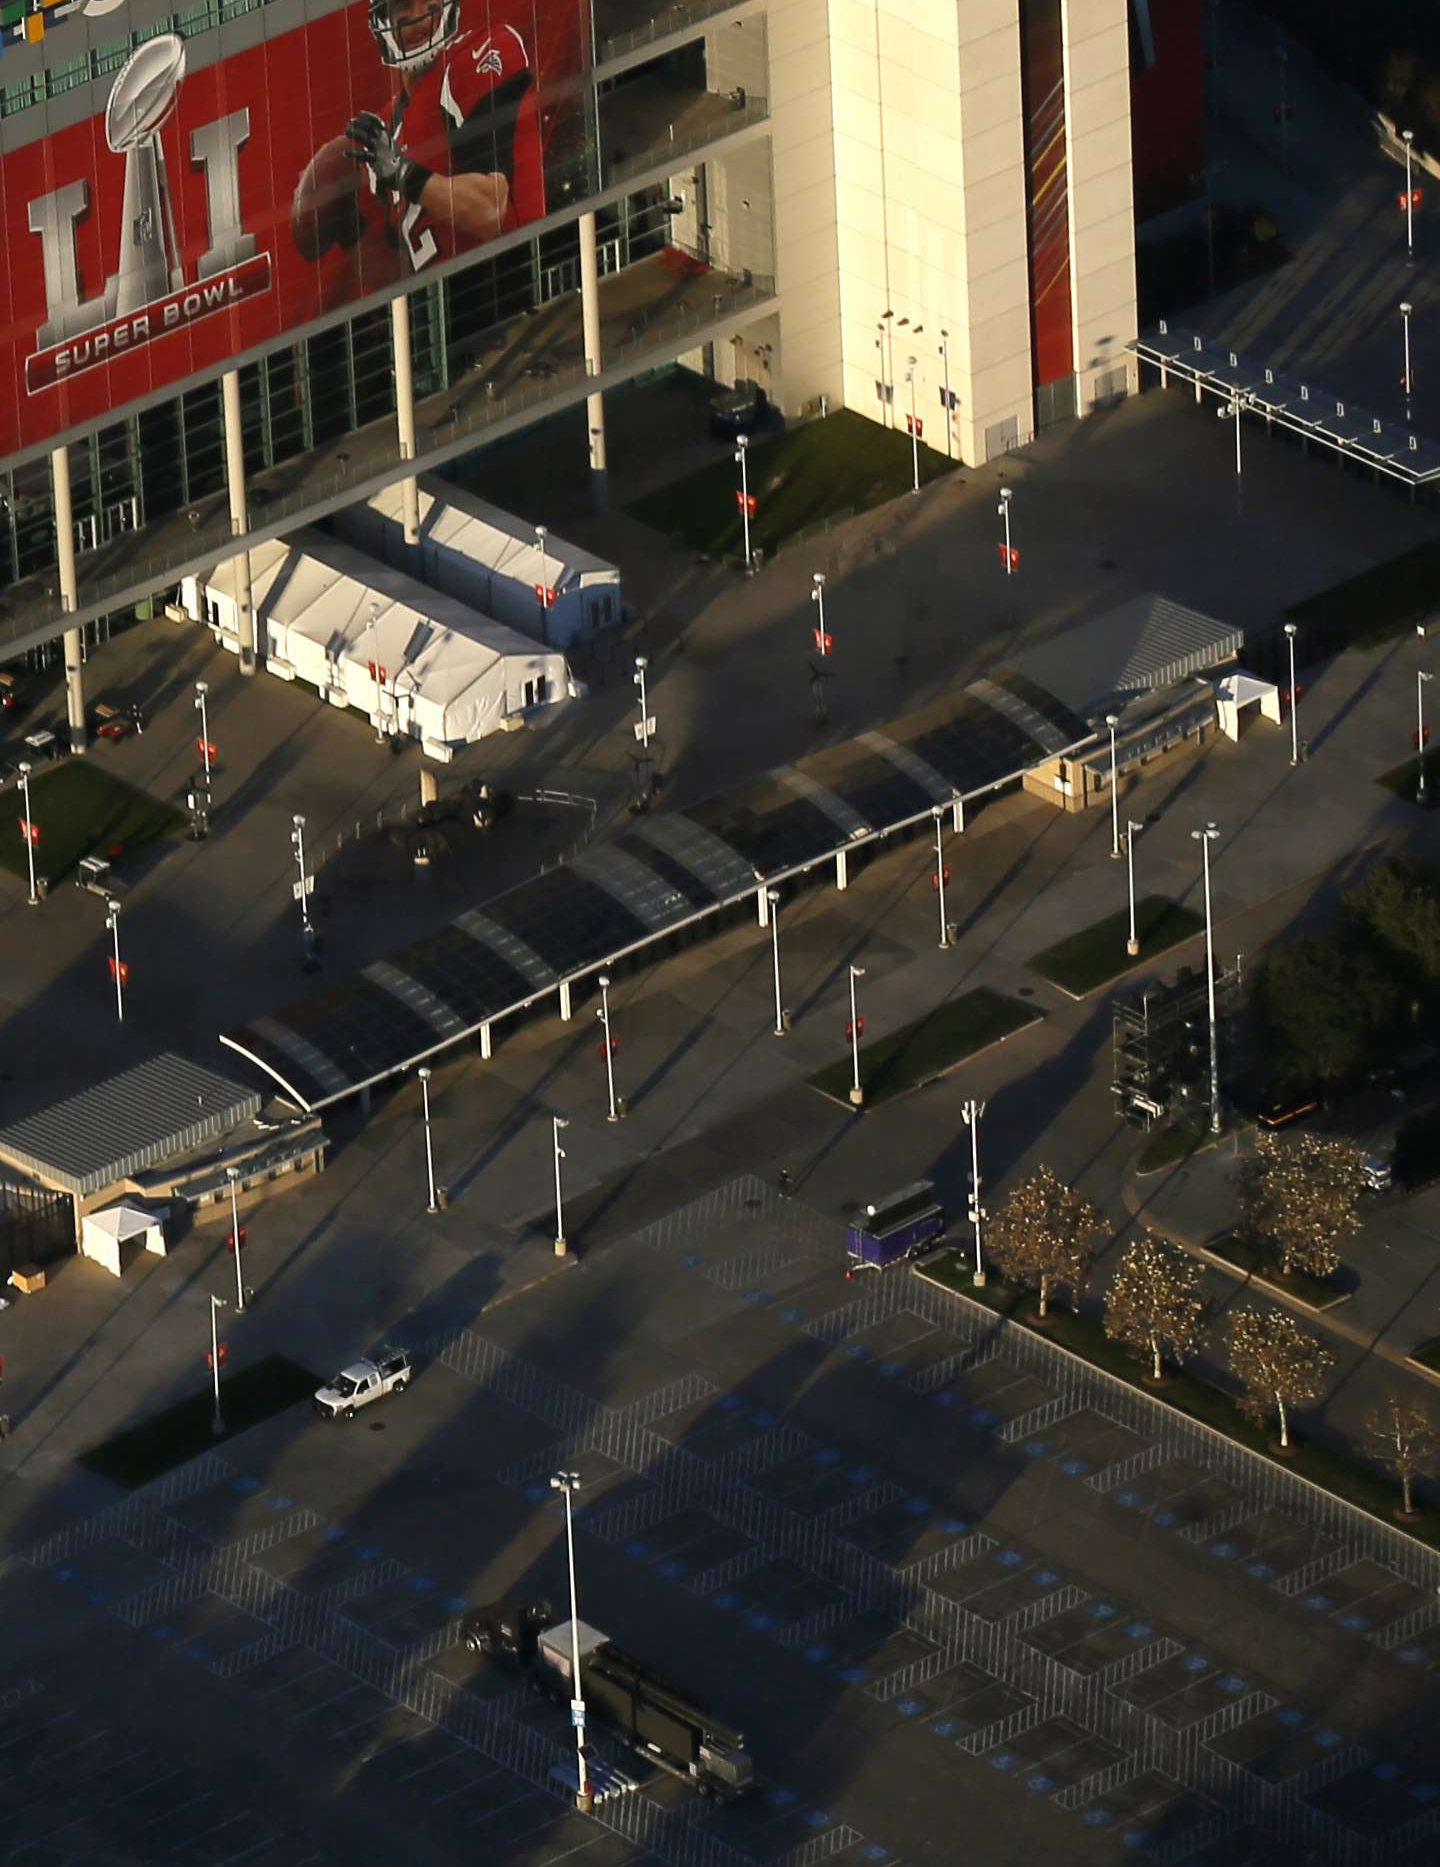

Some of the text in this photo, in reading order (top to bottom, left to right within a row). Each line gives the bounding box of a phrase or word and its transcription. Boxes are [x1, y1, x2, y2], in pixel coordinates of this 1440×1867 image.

[27, 106, 257, 352] LI
[54, 278, 243, 374] SUPER BOWL
